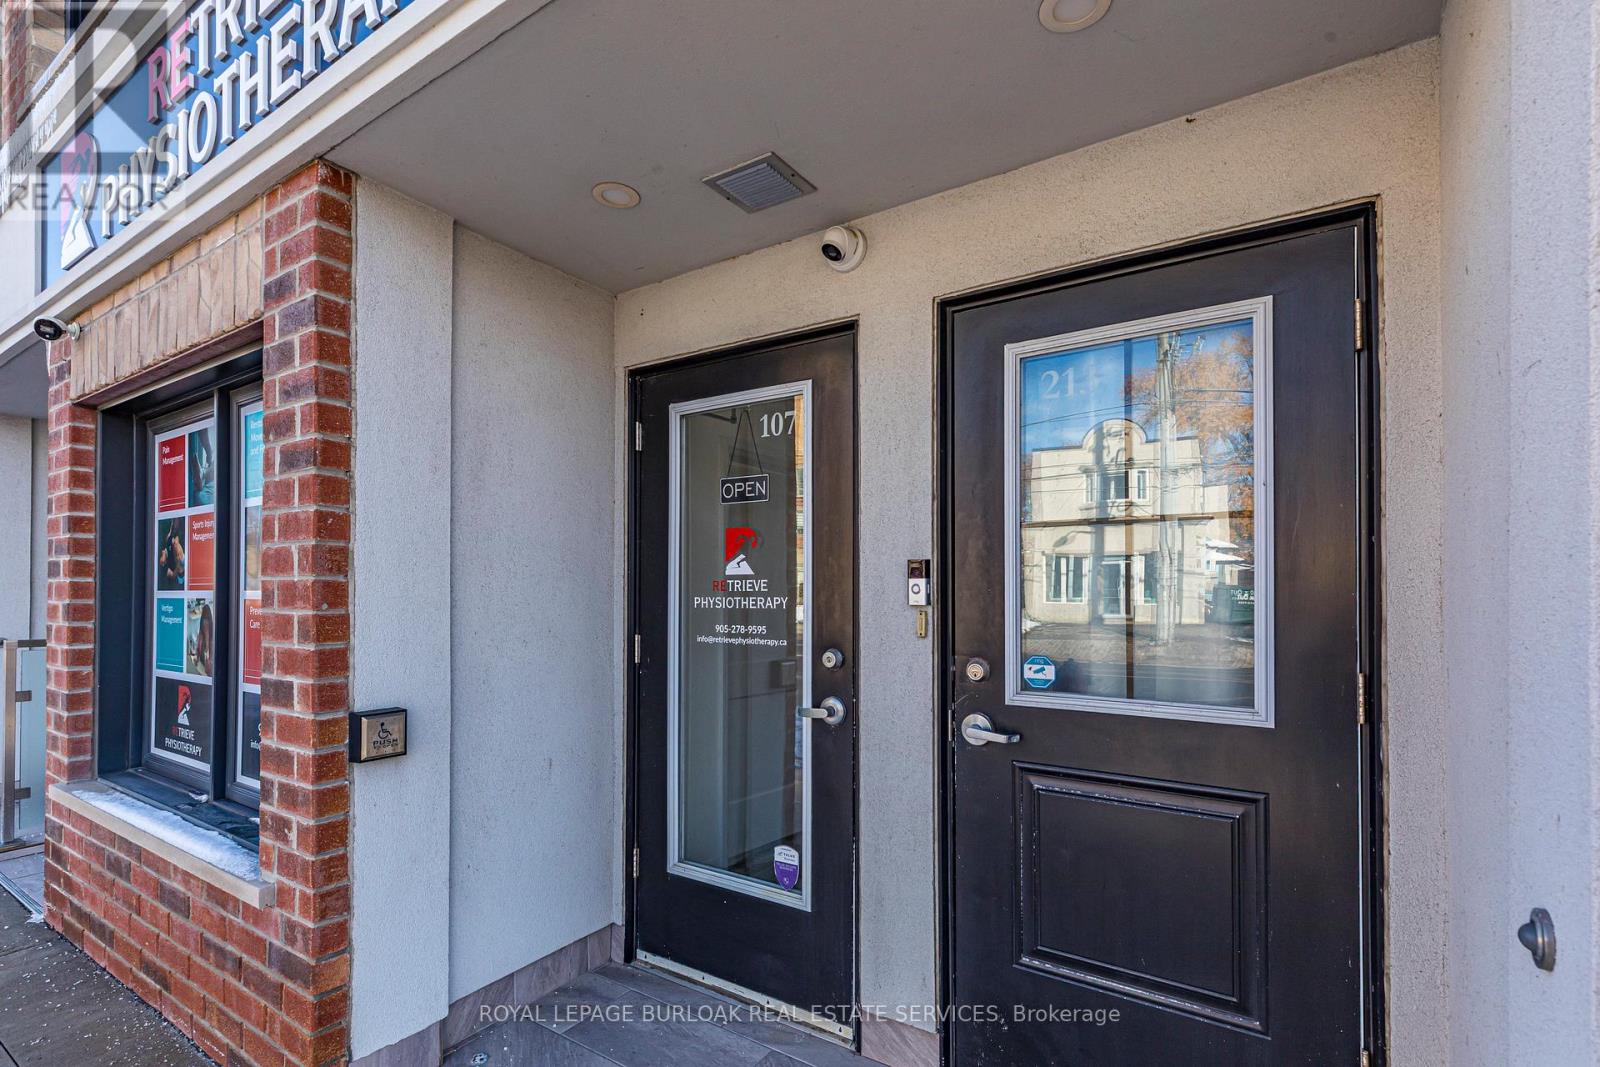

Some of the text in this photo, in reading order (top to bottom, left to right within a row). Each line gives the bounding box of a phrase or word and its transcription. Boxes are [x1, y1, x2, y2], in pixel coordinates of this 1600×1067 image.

[147, 0, 290, 123] RETR
[102, 0, 398, 238] PHYSIOTHERA
[760, 410, 796, 438] 107
[162, 446, 170, 454] Pain
[162, 454, 184, 465] Management
[722, 480, 766, 499] OPEN
[192, 520, 204, 531] Sports
[712, 578, 768, 592] RETRIEVE
[694, 596, 788, 609] PHYSIOTHERAPY
[250, 606, 262, 616] Preve
[715, 624, 767, 635] 905-278-9595
[697, 634, 787, 647] info@retrievephysiotherapy.ca
